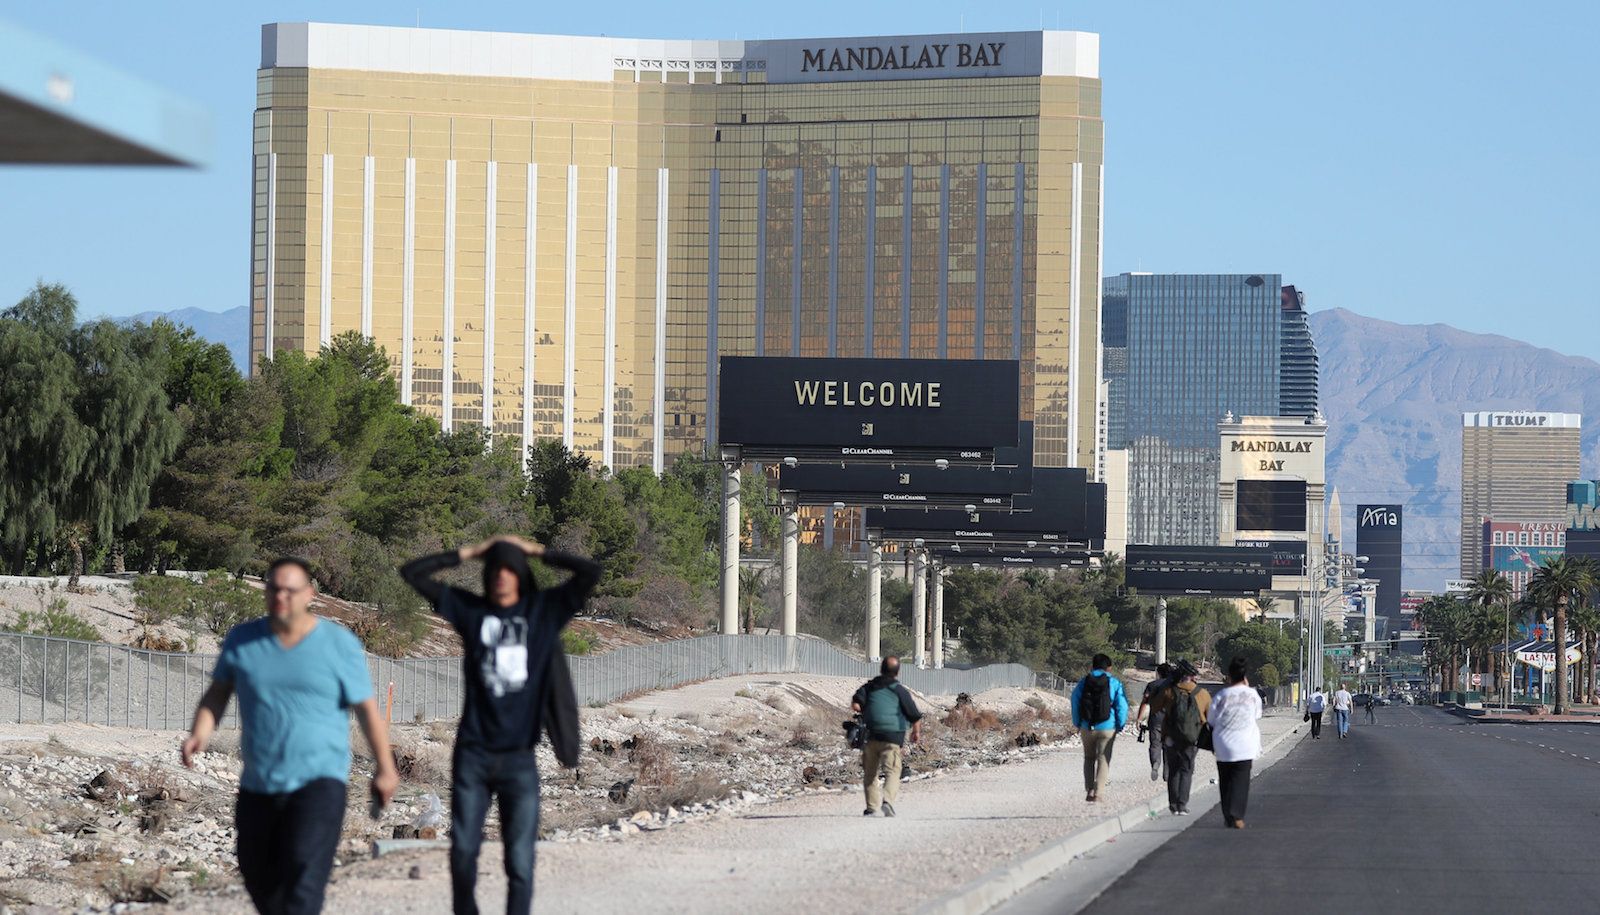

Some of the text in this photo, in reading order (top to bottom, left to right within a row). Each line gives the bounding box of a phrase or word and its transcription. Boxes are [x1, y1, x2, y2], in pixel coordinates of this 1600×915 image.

[801, 42, 1005, 72] MANDALAY BAY
[794, 380, 941, 407] WELCOME
[1494, 415, 1547, 426] TRUMP
[1230, 440, 1313, 453] MANDALAY
[1259, 460, 1285, 471] BAY
[1361, 507, 1397, 527] Aria
